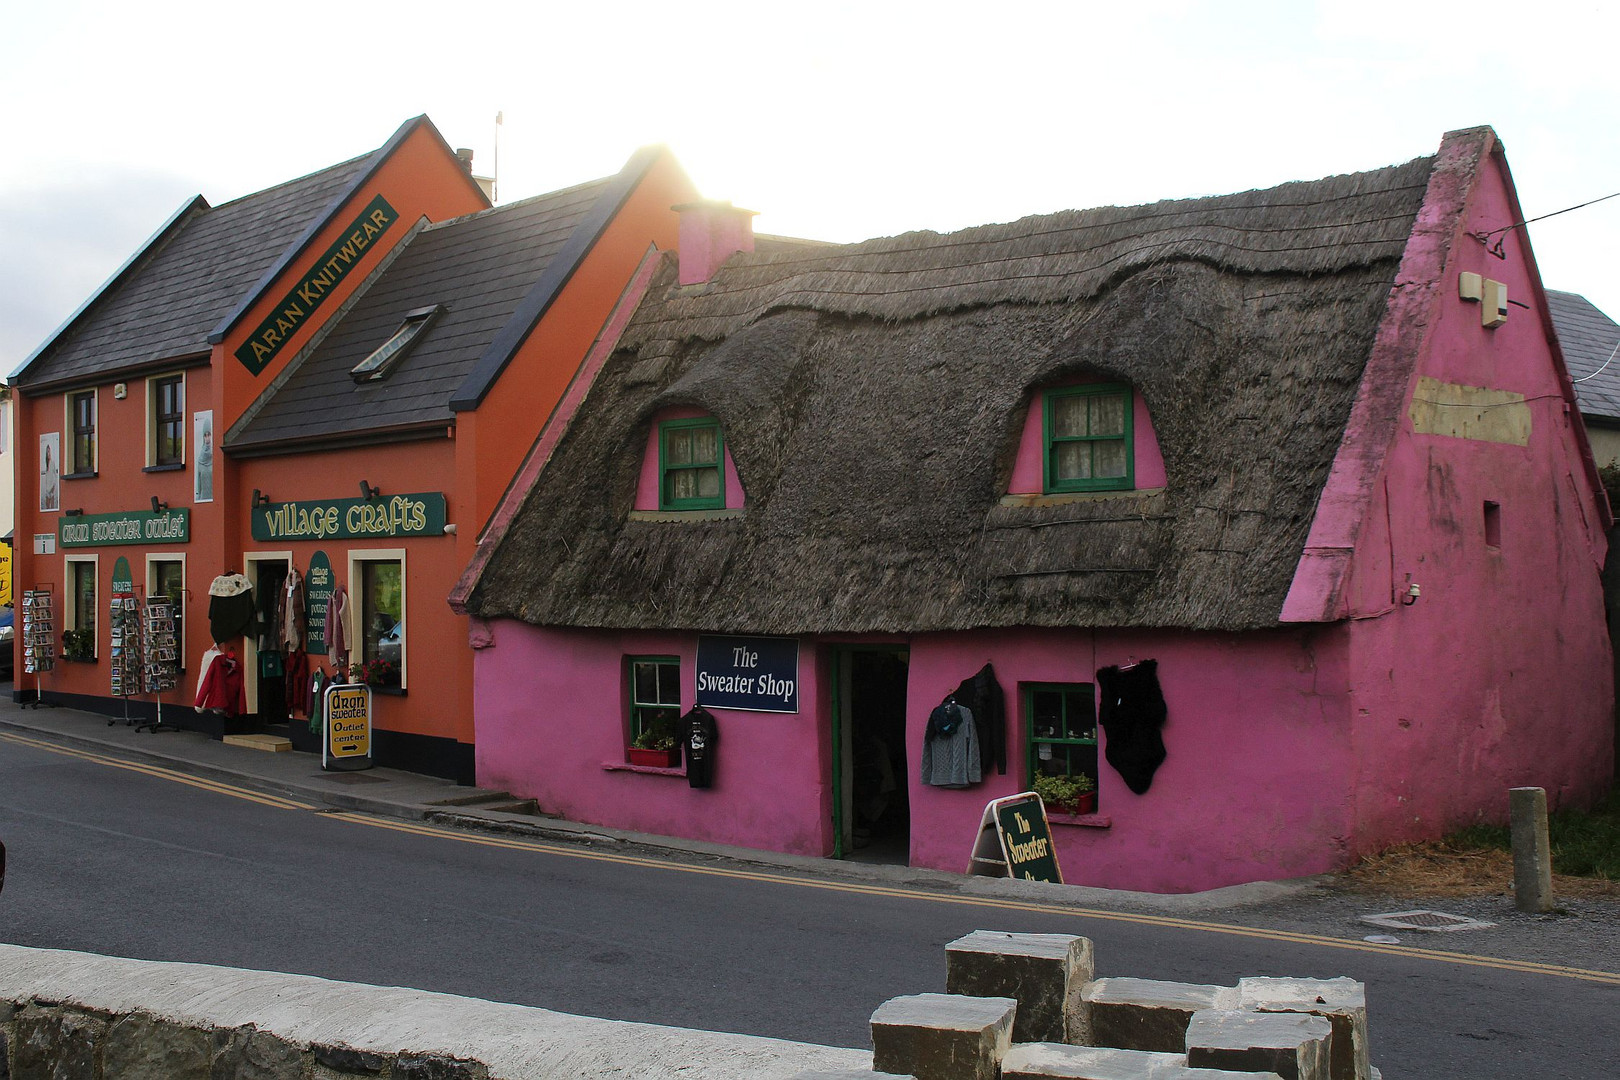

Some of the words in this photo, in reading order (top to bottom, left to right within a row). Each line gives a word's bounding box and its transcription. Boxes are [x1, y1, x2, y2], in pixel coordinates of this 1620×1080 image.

[250, 302, 304, 364] ARAN
[297, 208, 390, 307] KNITWEAR
[92, 517, 142, 541] sweater
[145, 512, 185, 539] outlet
[265, 503, 340, 539] Village
[733, 646, 758, 668] The
[698, 671, 755, 694] Sweater
[757, 673, 794, 703] Shop
[331, 708, 367, 720] sweater
[333, 722, 365, 732] Outlet
[333, 734, 365, 743] centre
[1013, 811, 1031, 834] The
[1006, 832, 1048, 864] Sweater
